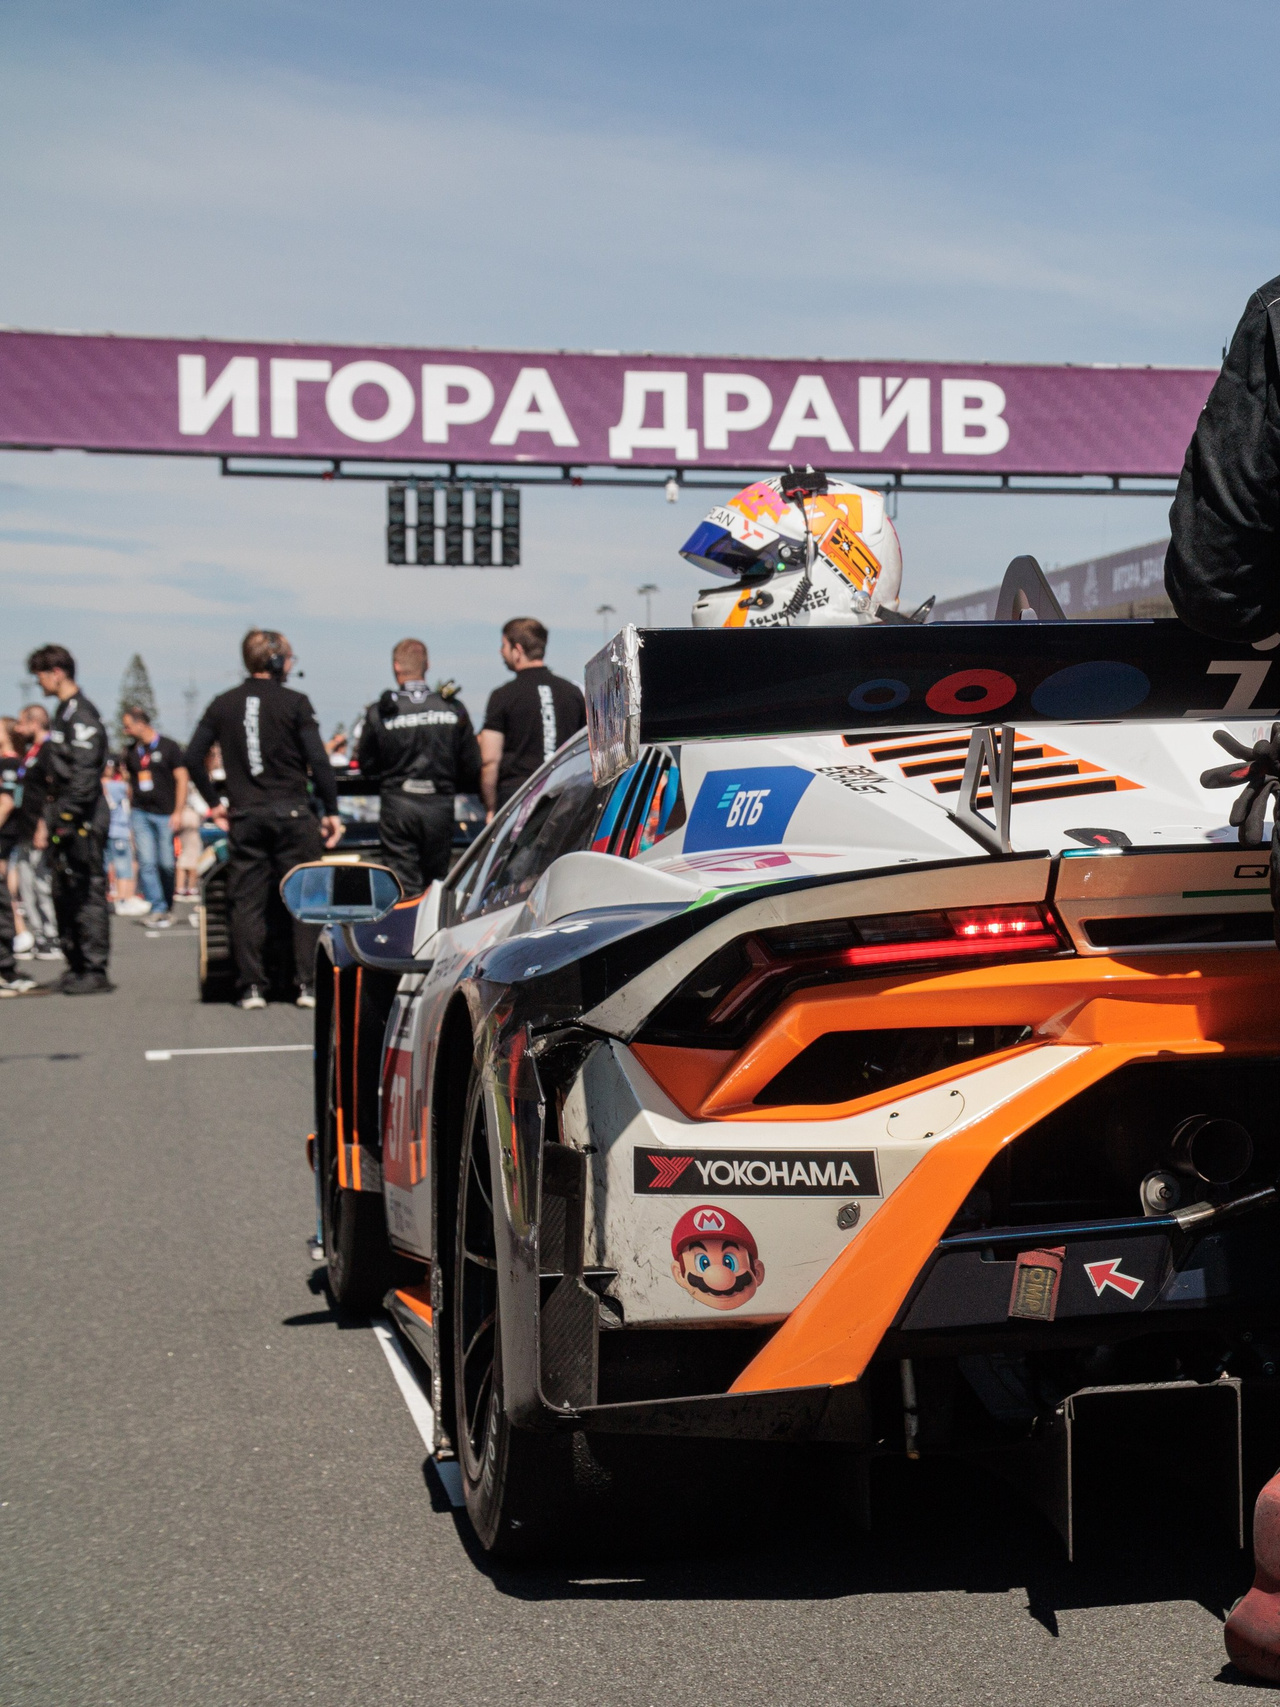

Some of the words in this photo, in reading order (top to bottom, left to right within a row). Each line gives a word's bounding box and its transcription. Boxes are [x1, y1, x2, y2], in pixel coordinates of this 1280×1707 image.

[177, 353, 581, 448] ИГОРА
[608, 369, 1010, 462] ДРАЙВ
[726, 789, 771, 828] ВТБ
[695, 1160, 860, 1187] YOKOHAMA
